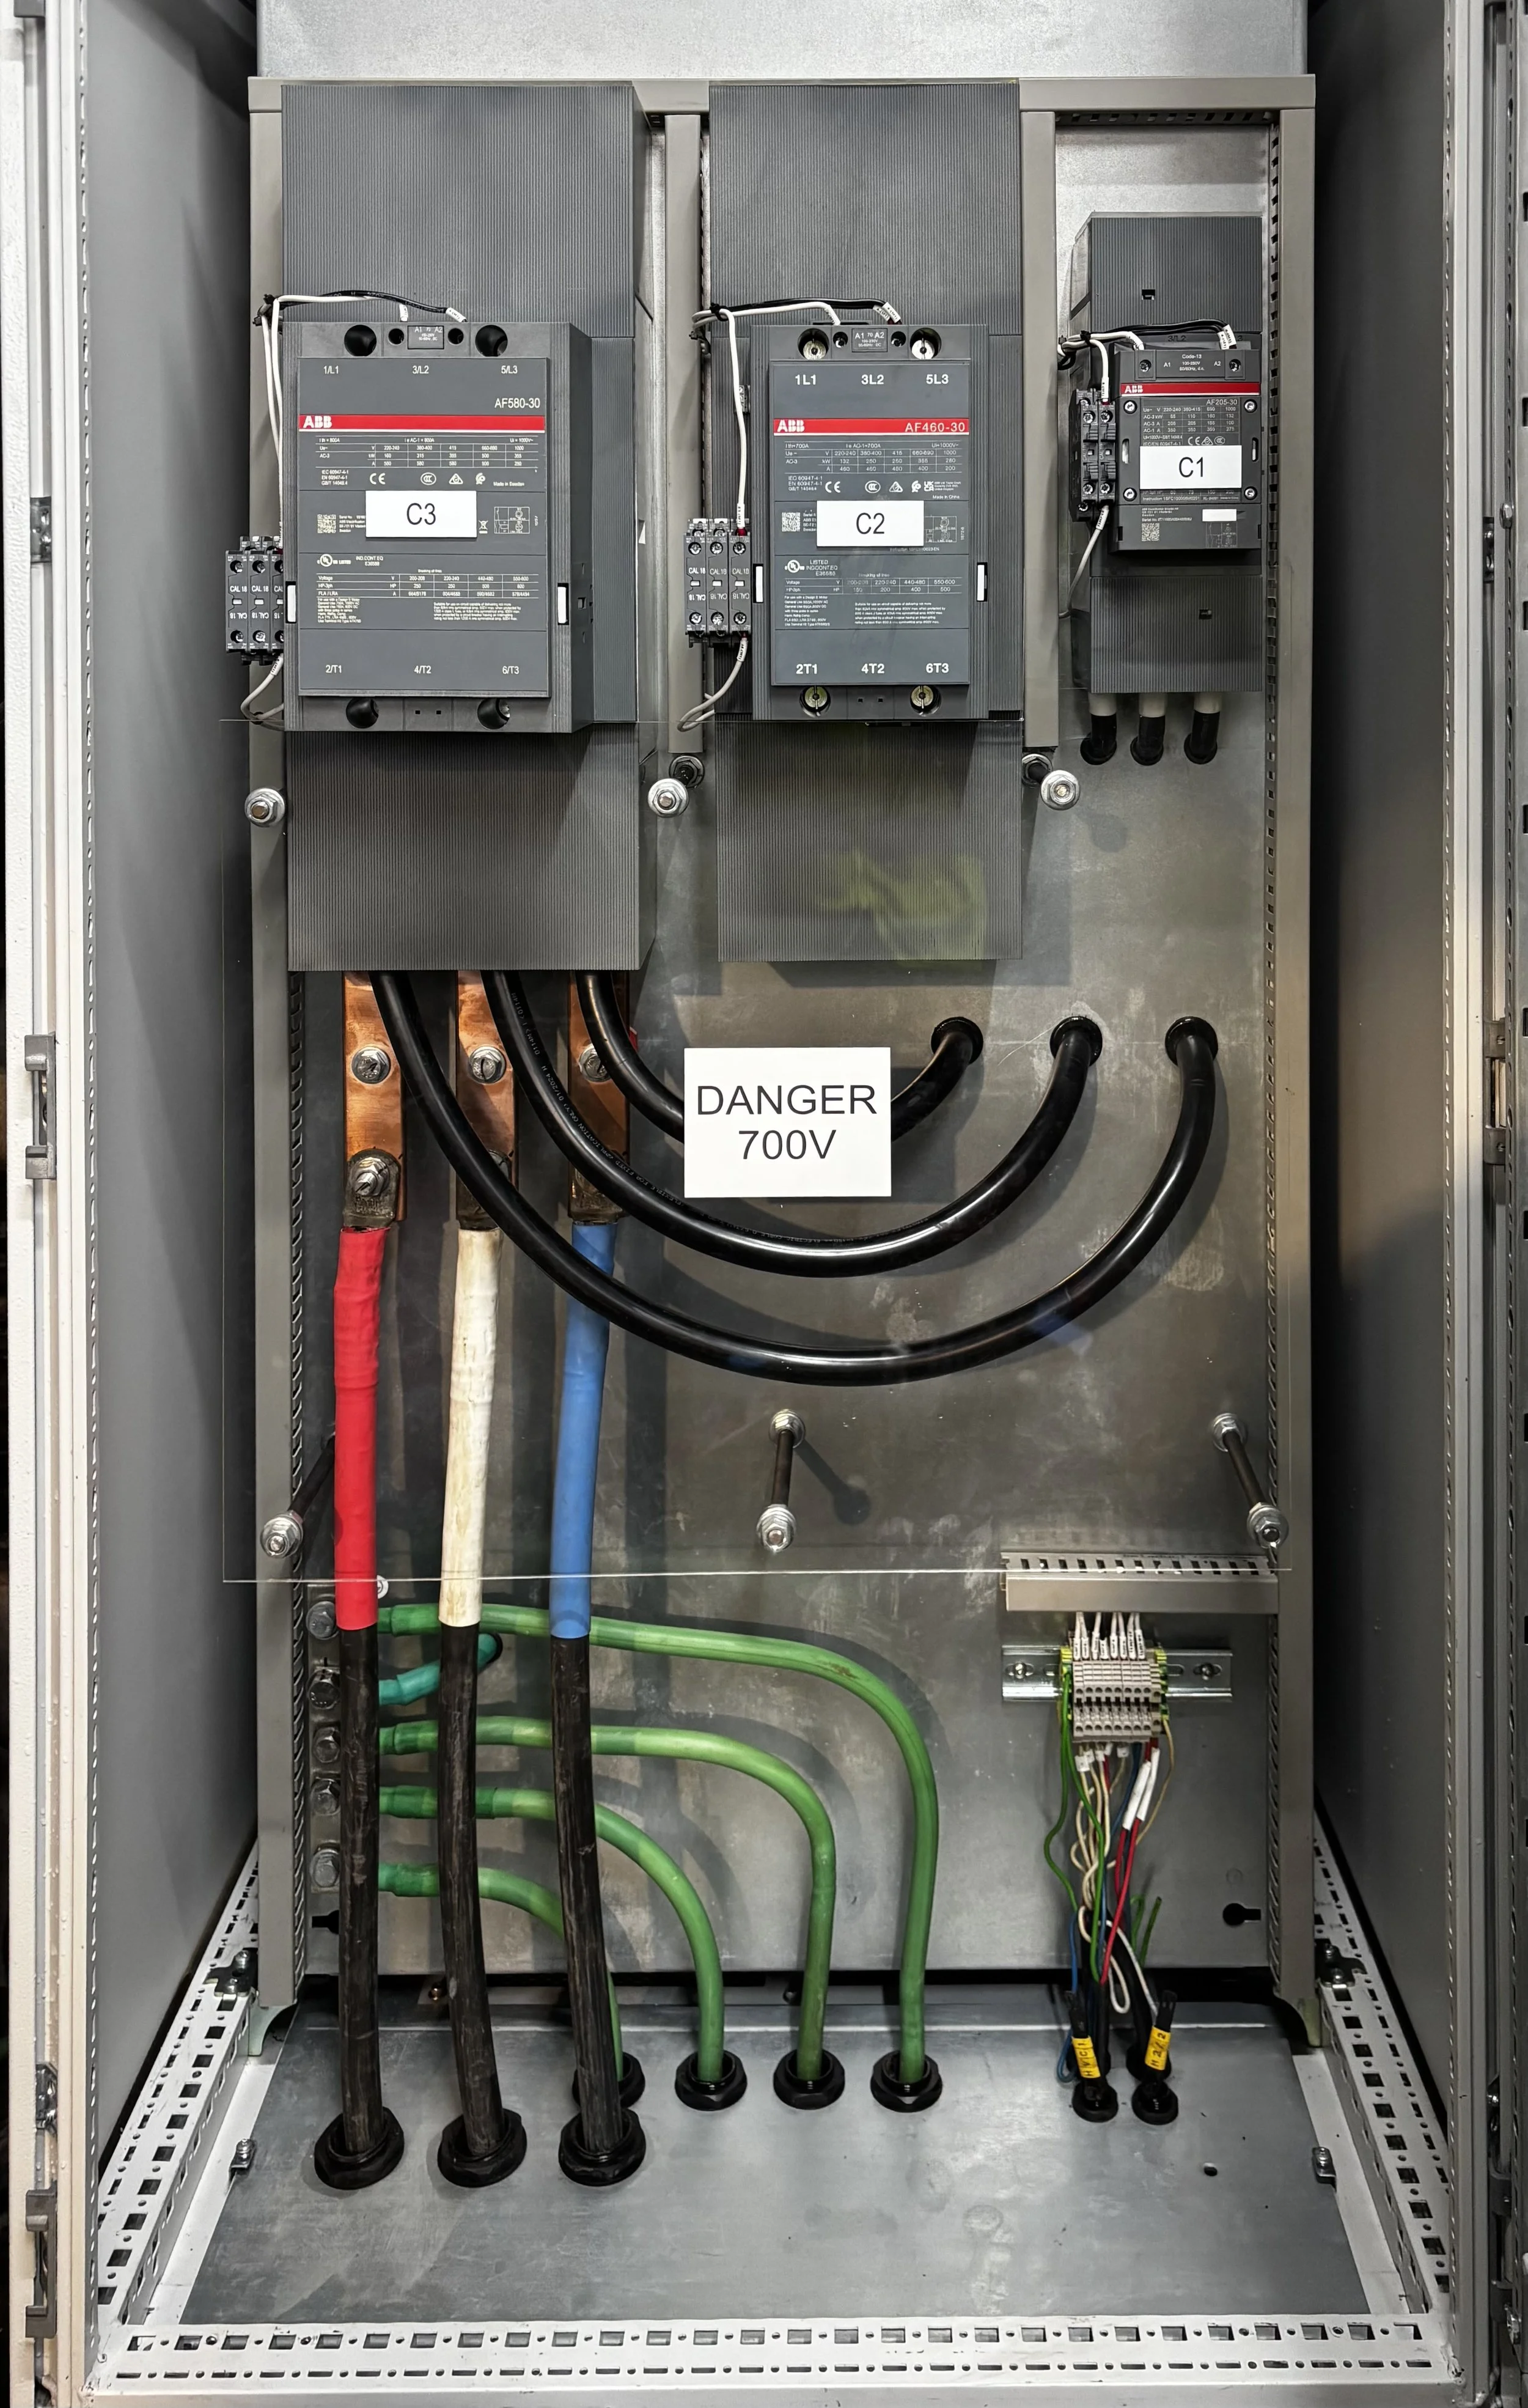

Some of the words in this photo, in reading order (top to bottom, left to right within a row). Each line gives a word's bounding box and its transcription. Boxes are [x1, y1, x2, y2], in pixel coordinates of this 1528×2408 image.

[323, 365, 339, 374] 1/L1
[412, 365, 429, 374] 3/L2
[501, 365, 518, 374] 5/L3
[795, 375, 817, 385] 1L1
[861, 375, 884, 385] 3L2
[926, 374, 949, 385] 5L3
[1125, 385, 1143, 393] ABB
[494, 398, 540, 408] AF580-30
[303, 415, 332, 428] ABB
[777, 419, 805, 432] ABB
[905, 422, 965, 432] AF460-30
[1178, 457, 1205, 478] C1
[406, 503, 436, 525] C3
[856, 512, 885, 534] C2
[326, 665, 342, 674] 2/T1
[414, 665, 432, 674] 4/T2
[502, 666, 520, 675] 6/T3
[796, 664, 818, 674] 2T1
[861, 663, 885, 674] 4T2
[926, 663, 949, 672] 6T3
[546, 1073, 564, 1101] 01/2024
[698, 1084, 877, 1114] DANGER
[739, 1129, 837, 1160] 700V
